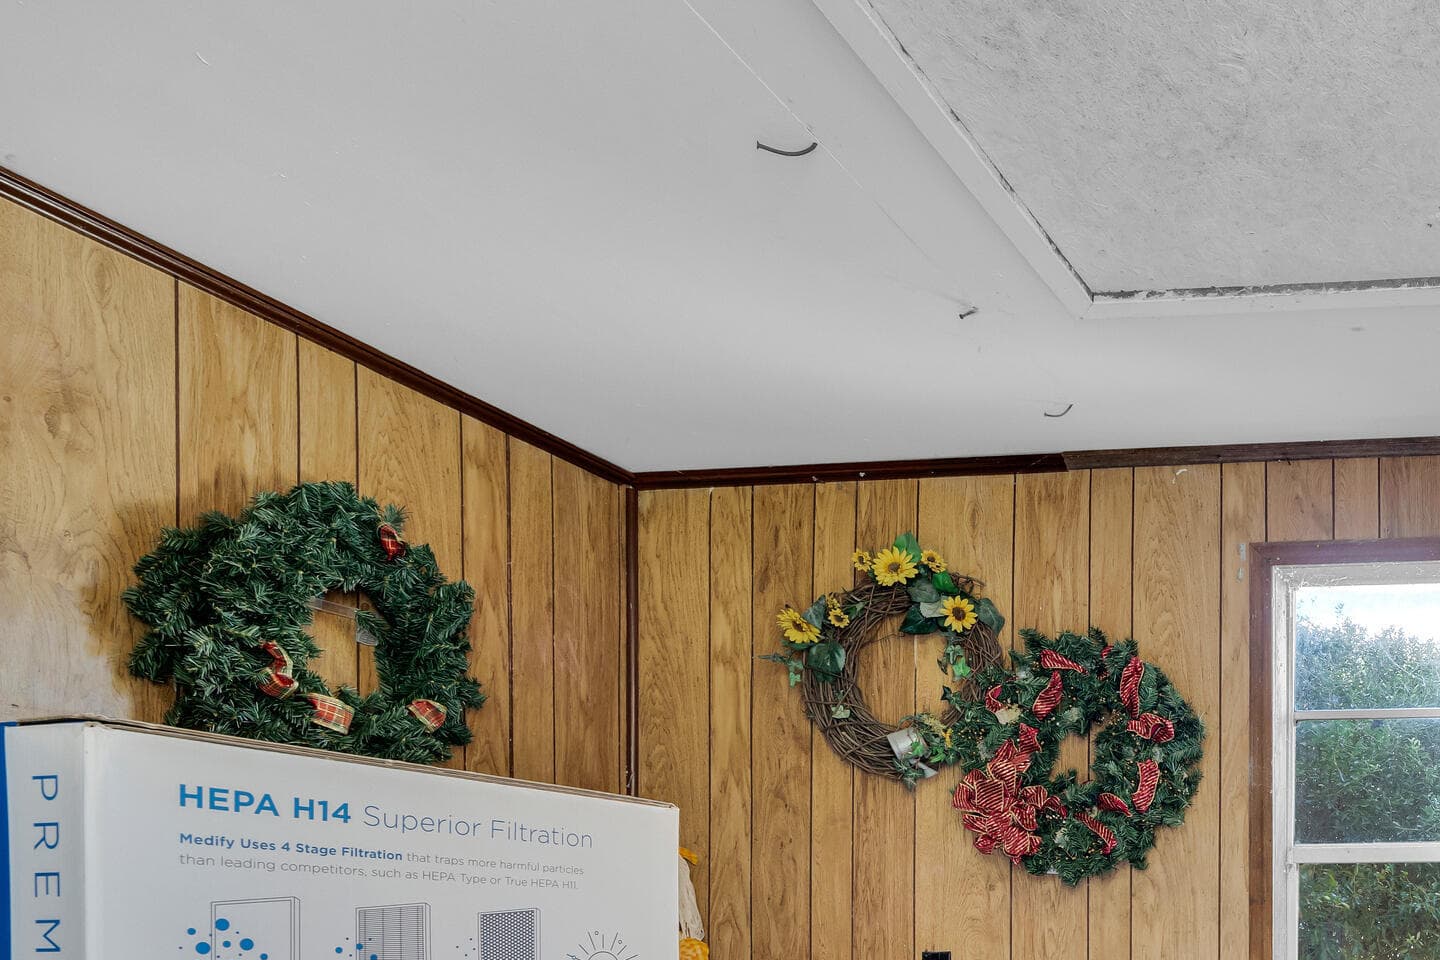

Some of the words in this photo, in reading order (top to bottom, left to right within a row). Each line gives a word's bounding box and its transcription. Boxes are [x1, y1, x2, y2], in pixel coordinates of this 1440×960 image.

[179, 784, 280, 817] HEPA
[293, 797, 351, 824] H14
[363, 805, 482, 837] Superior
[491, 819, 593, 849] Filtration
[179, 833, 234, 850] Medify
[240, 838, 276, 852] Uses
[281, 842, 290, 852] 4
[295, 843, 337, 857] Stage
[341, 847, 403, 861] Filtration
[407, 852, 431, 864] that
[435, 855, 465, 868] traps
[468, 858, 497, 869] more
[500, 860, 540, 873] harmful
[543, 864, 585, 876] particles
[179, 853, 216, 867] than
[221, 855, 276, 872] leading
[371, 868, 401, 880] such
[405, 871, 419, 880] as
[422, 871, 456, 883] HEPA
[461, 873, 487, 886] Type
[490, 875, 501, 885] or
[505, 876, 528, 887] True
[530, 878, 560, 888] HEPA
